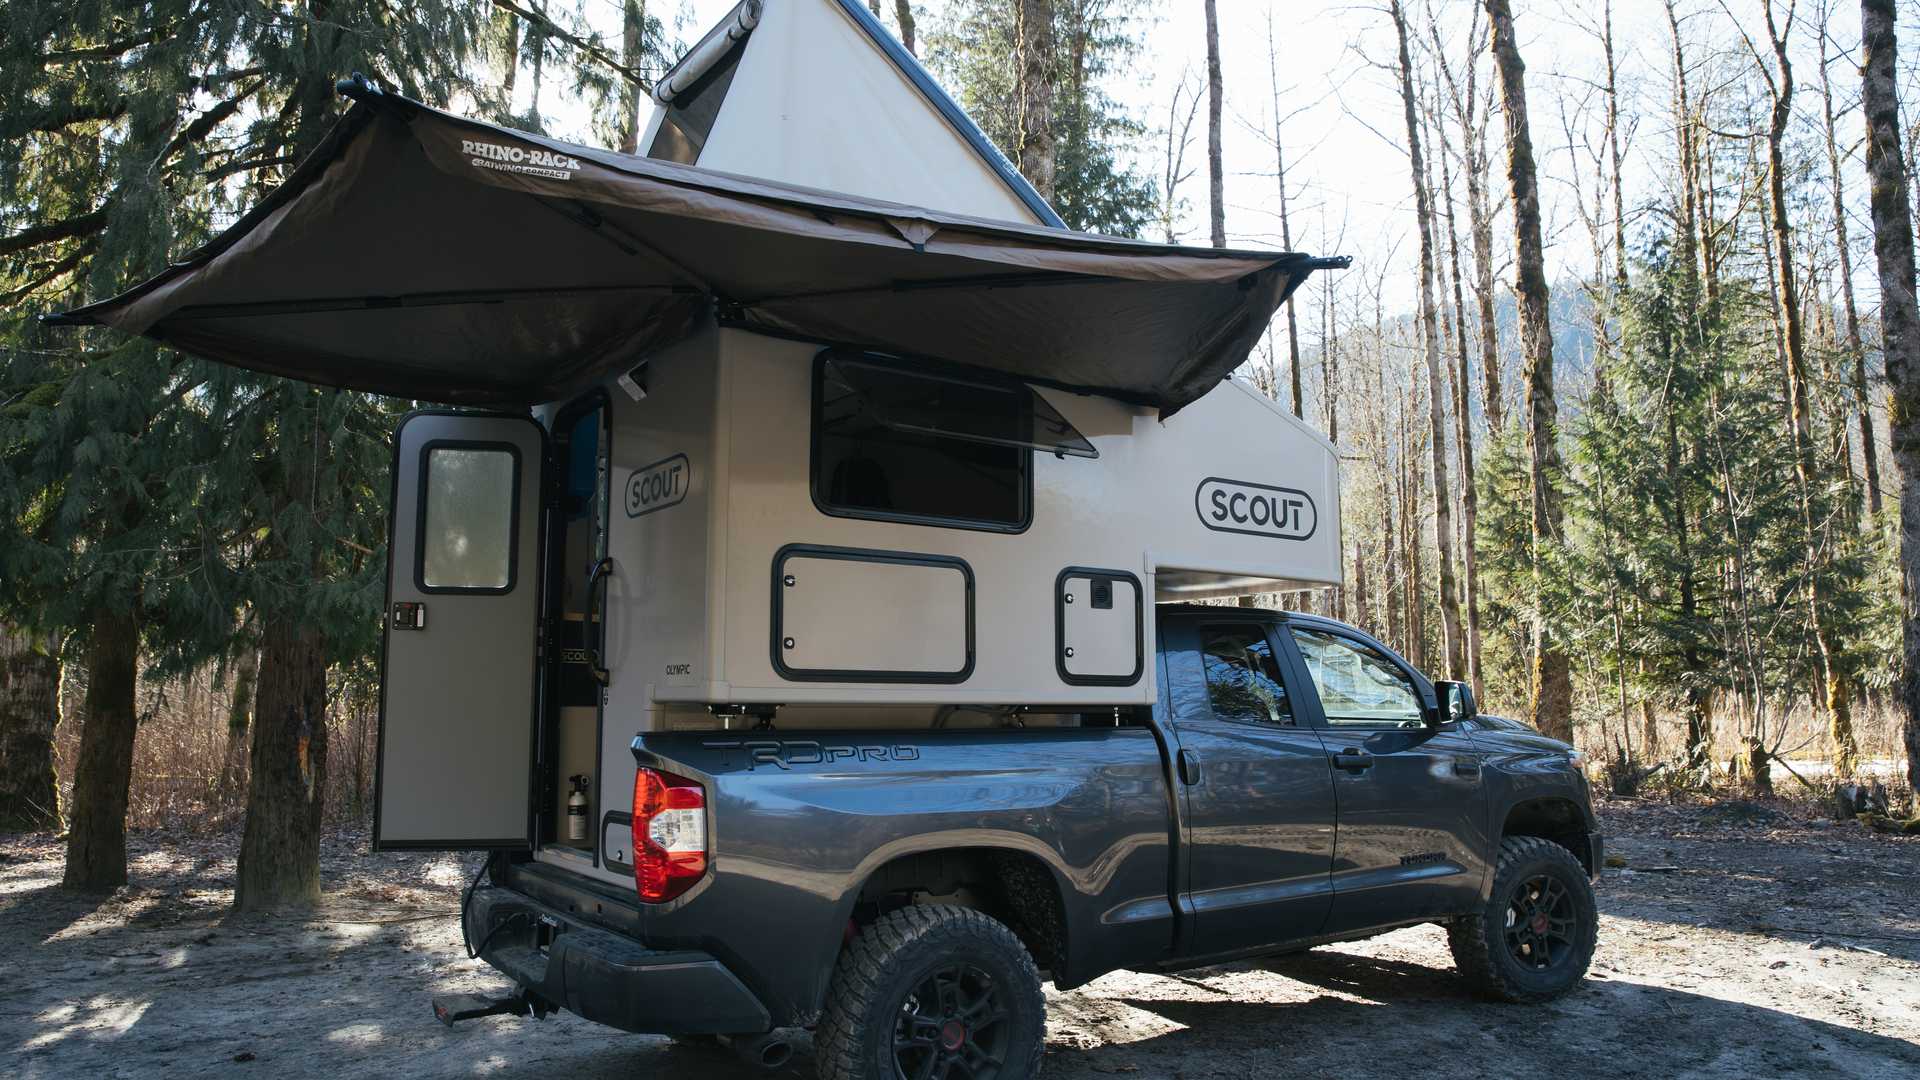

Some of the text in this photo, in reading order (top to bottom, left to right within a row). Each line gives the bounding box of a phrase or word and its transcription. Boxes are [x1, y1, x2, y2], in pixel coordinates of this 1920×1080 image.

[462, 140, 580, 170] RHINO-RACK
[632, 466, 681, 508] SCOUT
[1211, 489, 1304, 531] SCOUT
[666, 663, 690, 675] OLYMPIC
[824, 745, 919, 763] PRO
